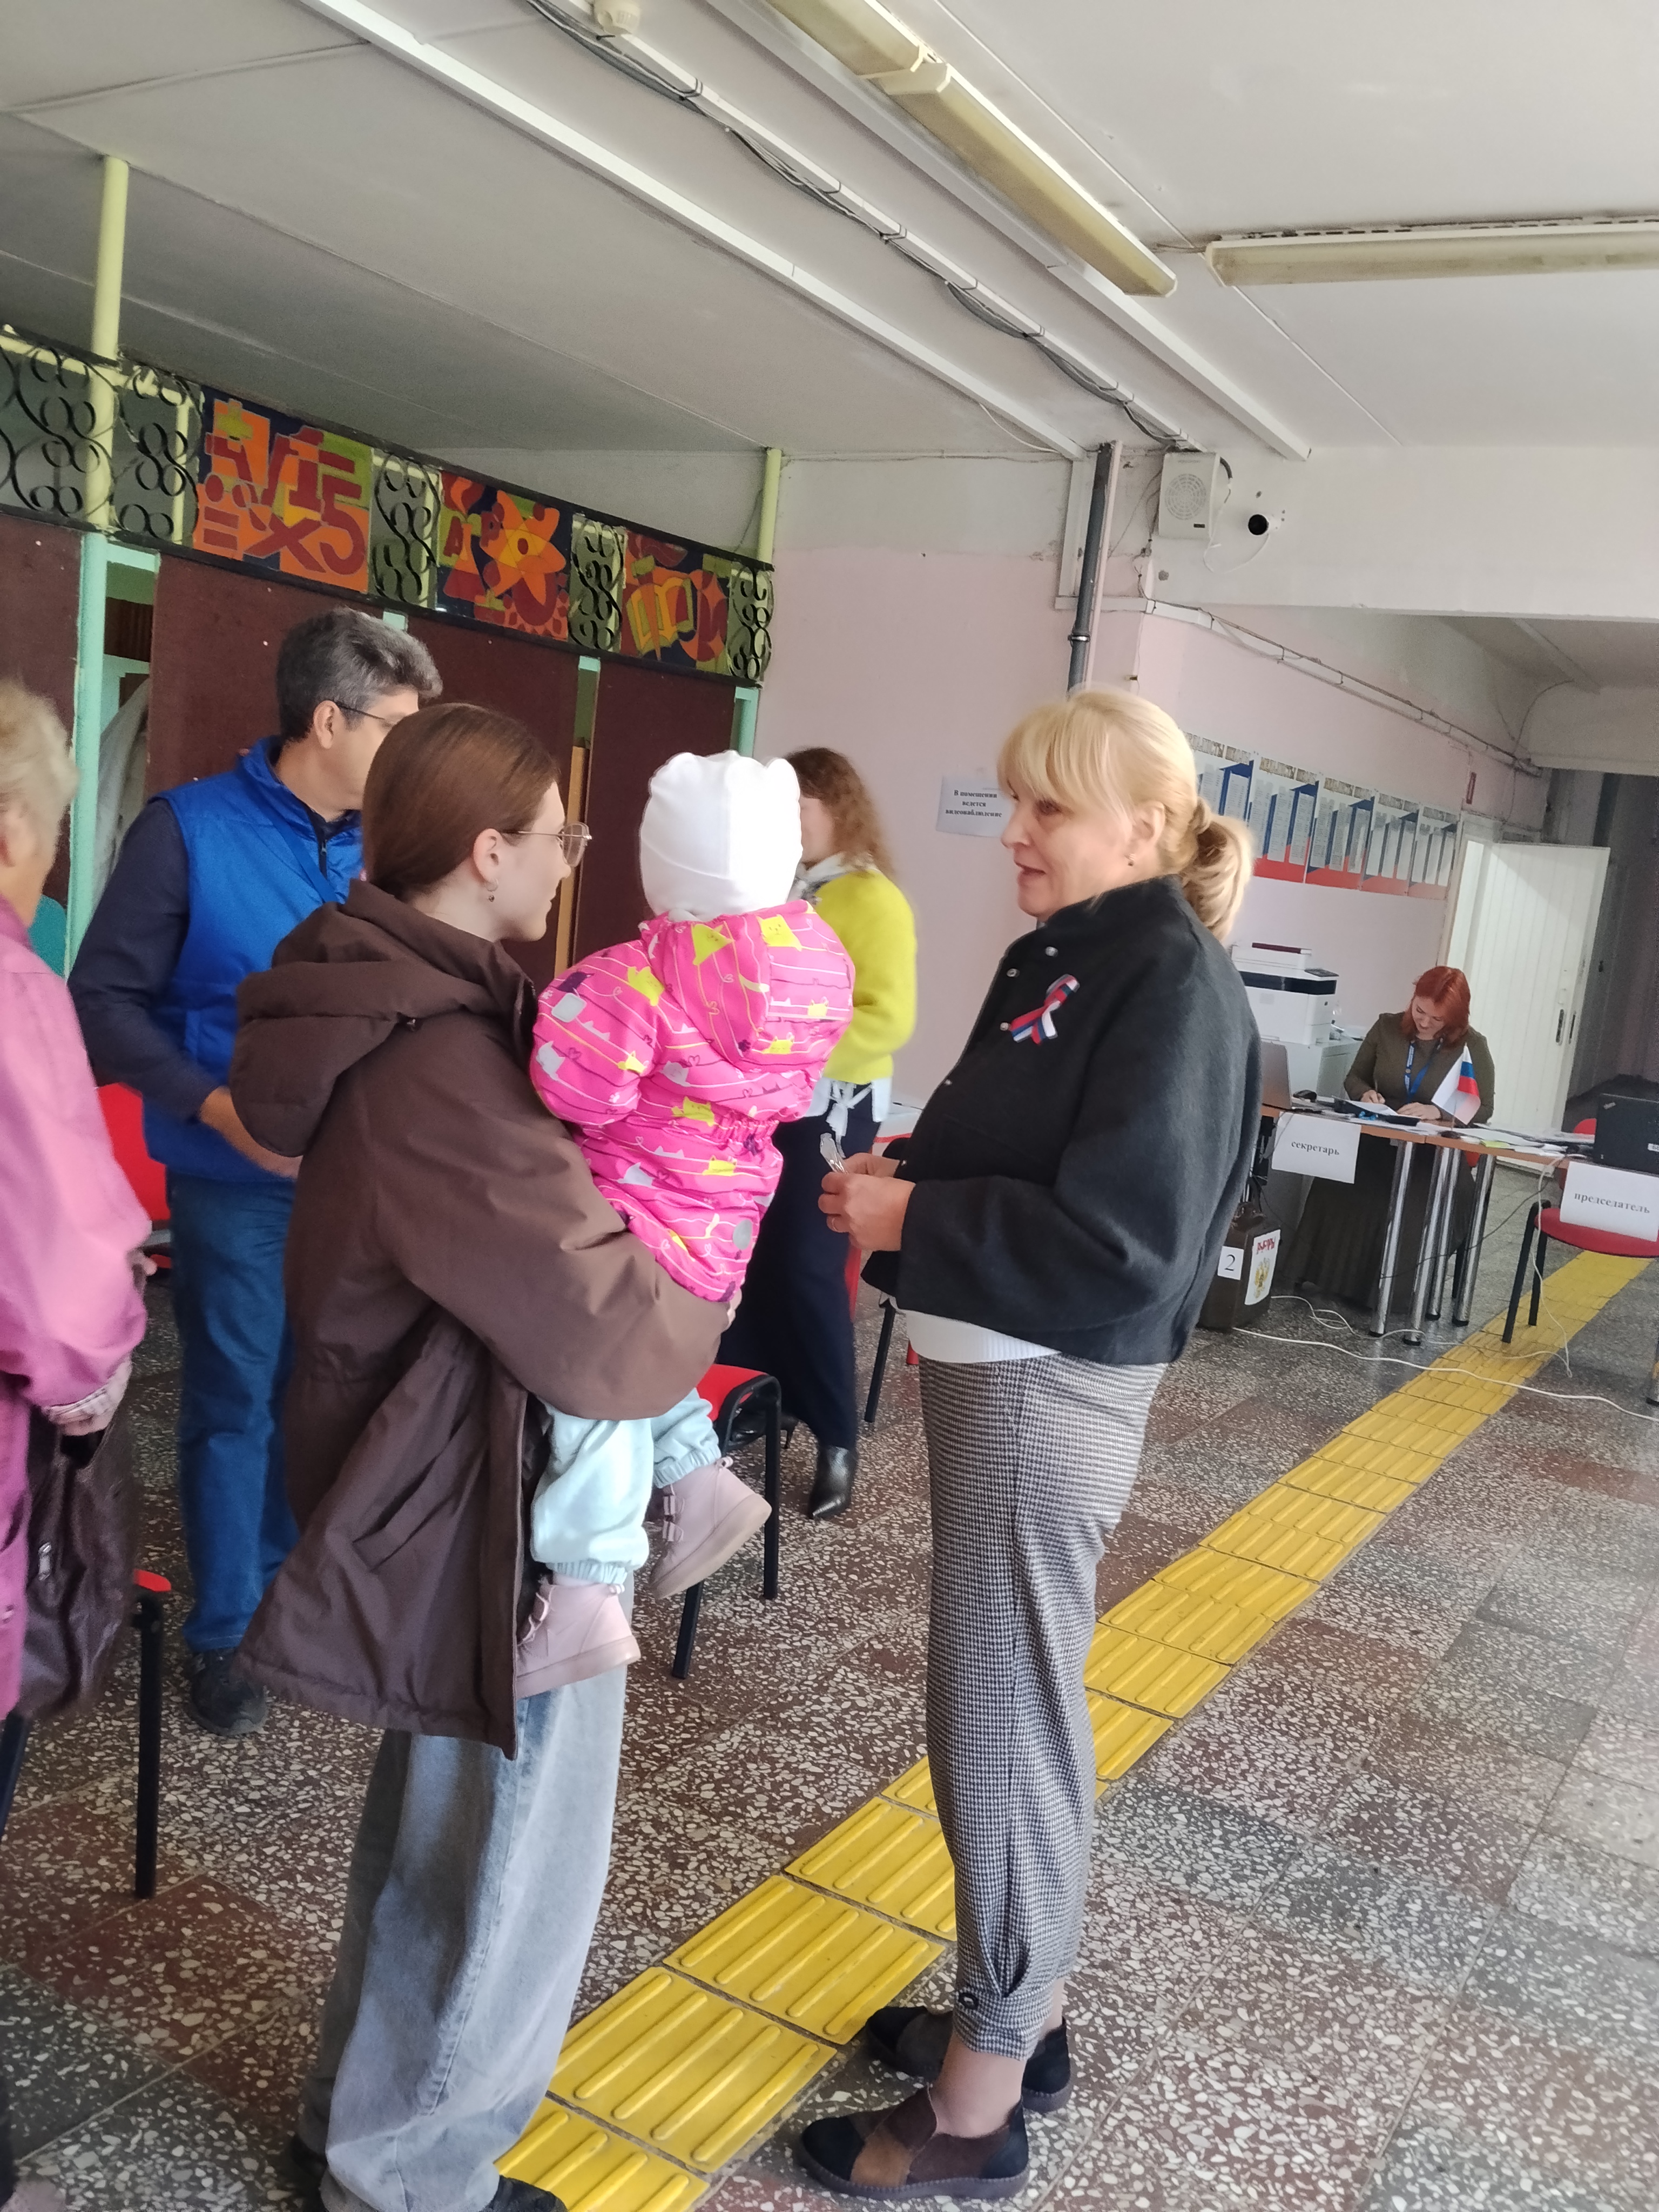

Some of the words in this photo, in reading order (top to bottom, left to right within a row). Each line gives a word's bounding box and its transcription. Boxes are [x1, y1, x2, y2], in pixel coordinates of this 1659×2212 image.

[1291, 1141, 1340, 1156] секретарь
[1574, 1192, 1650, 1213] председатель
[1224, 1254, 1235, 1271] 2
